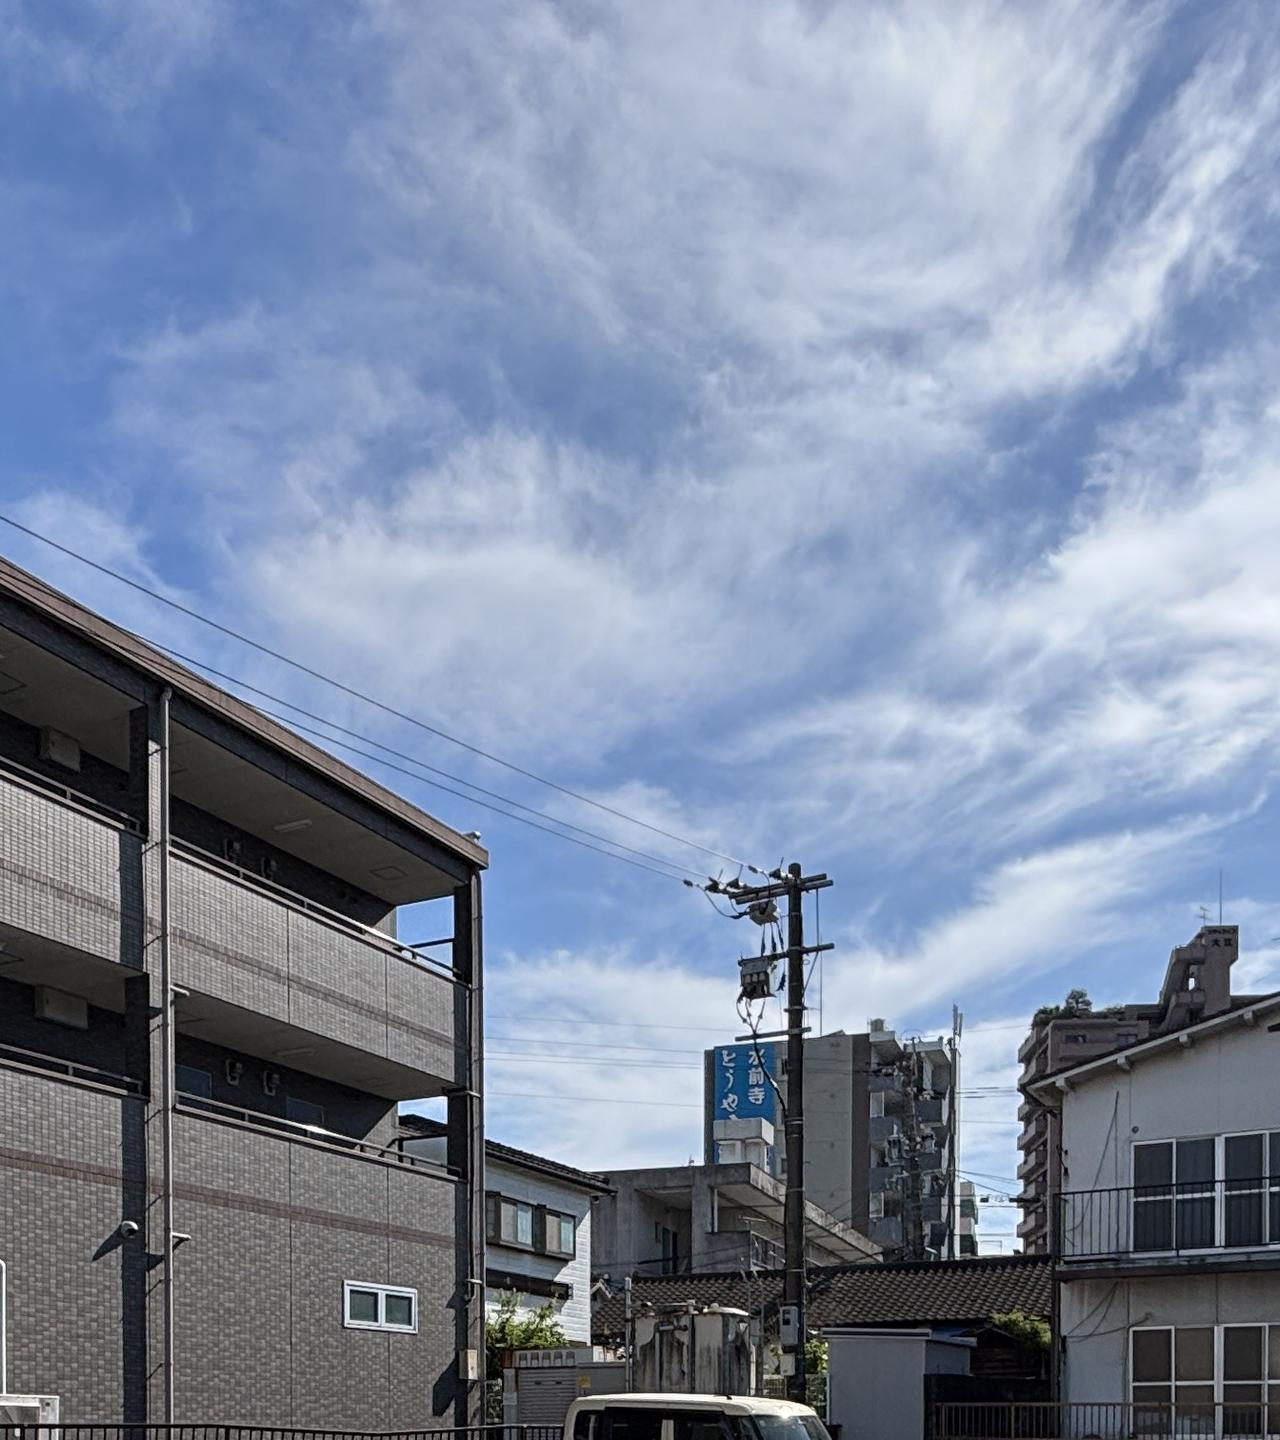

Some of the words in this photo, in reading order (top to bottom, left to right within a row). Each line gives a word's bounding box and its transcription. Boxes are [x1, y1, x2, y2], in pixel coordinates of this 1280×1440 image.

[720, 1049, 738, 1119] とうや
[748, 1049, 765, 1105] 水前寺
